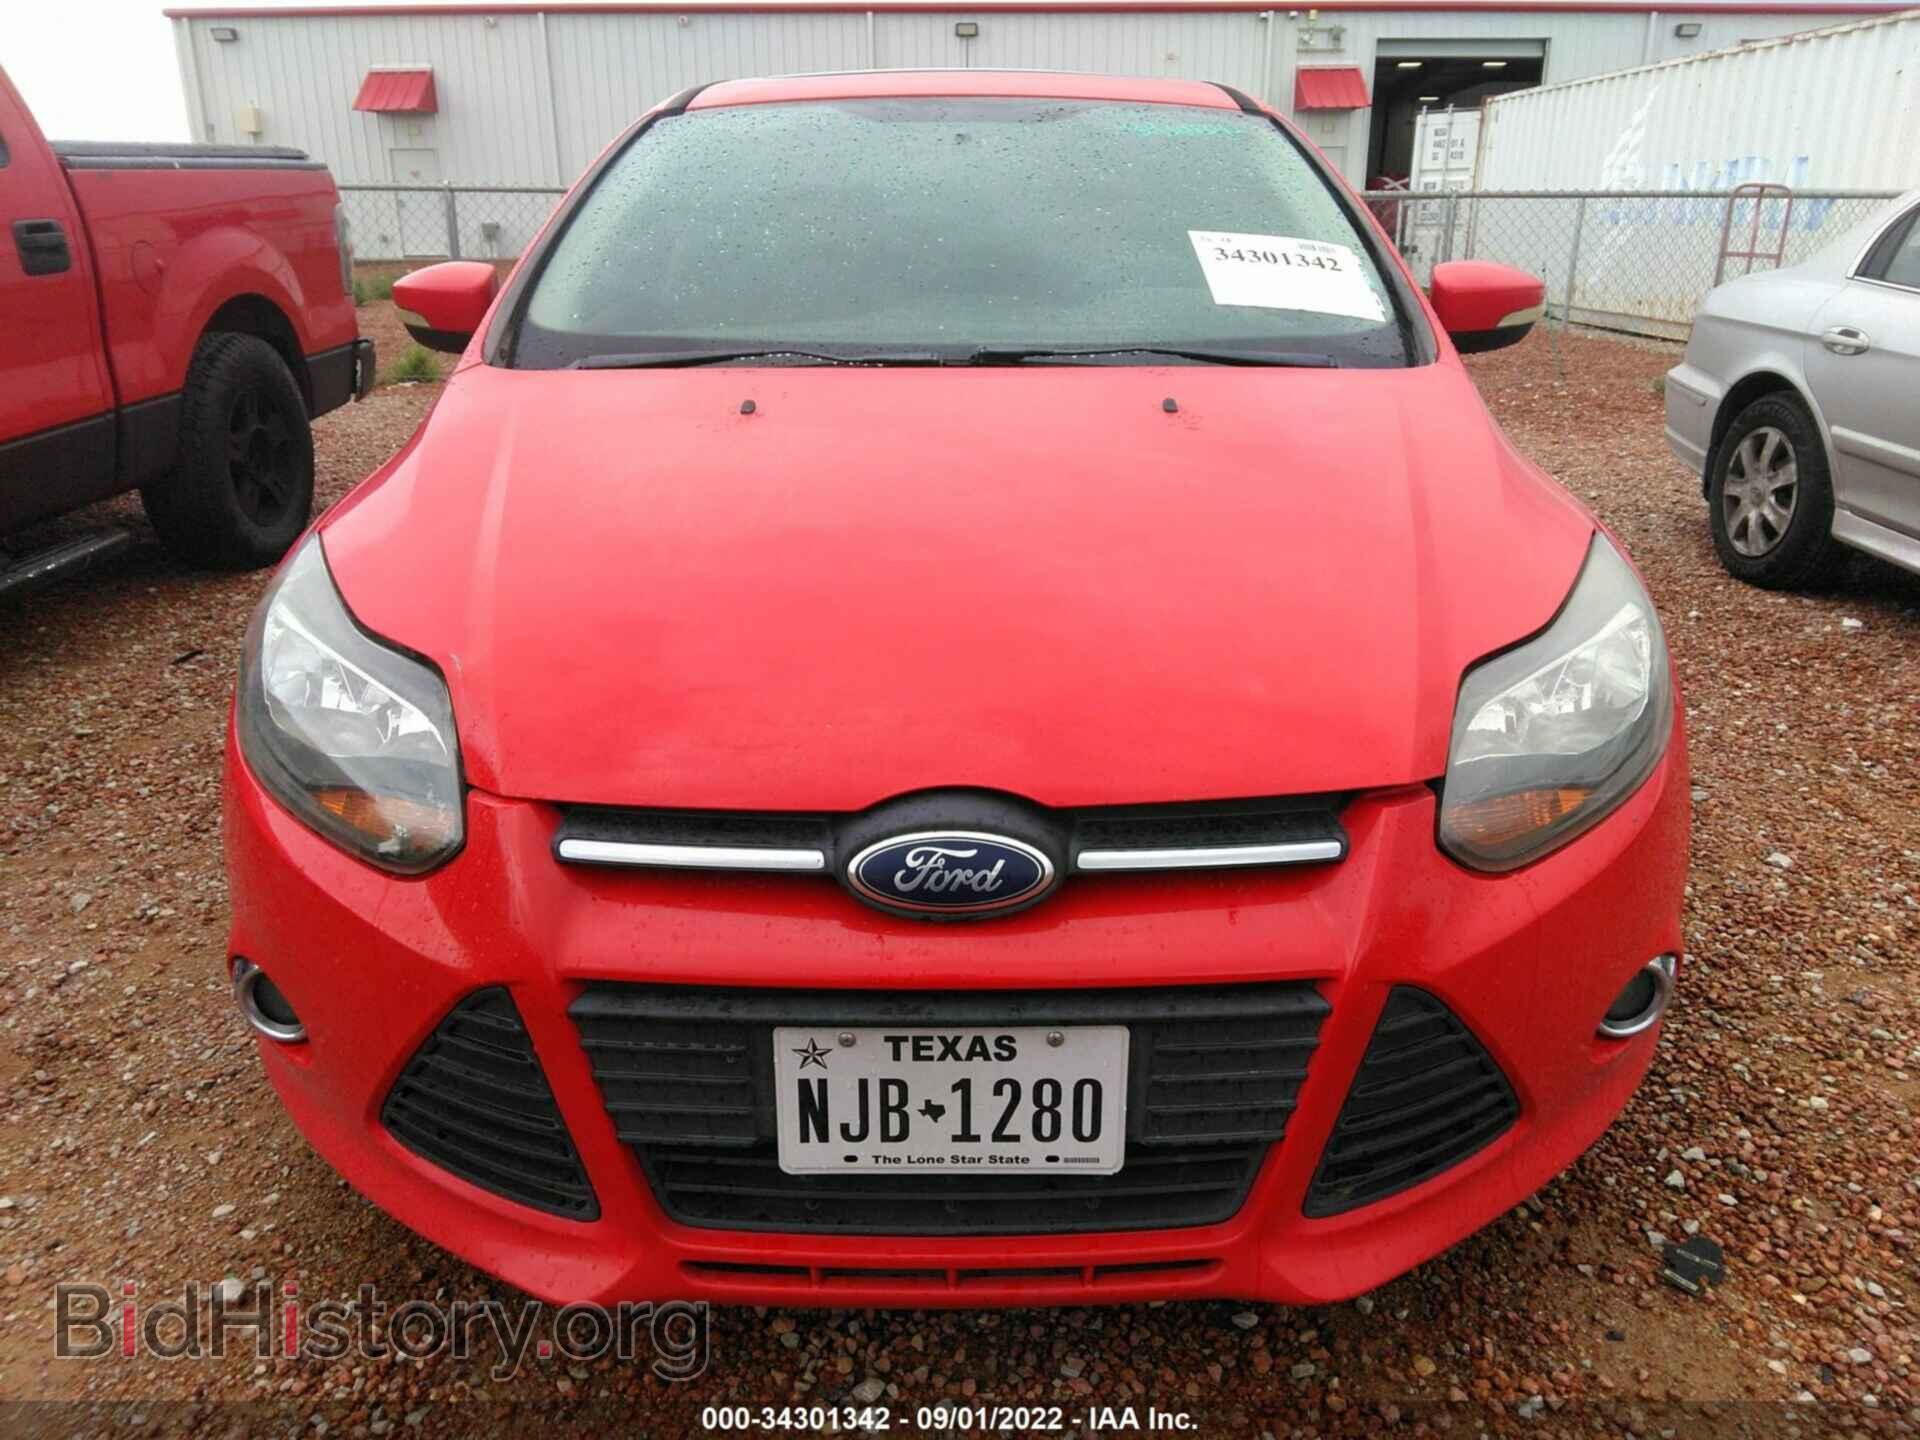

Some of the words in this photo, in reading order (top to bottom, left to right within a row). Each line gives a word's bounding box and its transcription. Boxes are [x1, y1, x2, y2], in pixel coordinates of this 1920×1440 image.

[1214, 247, 1342, 271] 34301342
[894, 846, 1006, 893] Ford
[883, 1034, 1018, 1062] TEXAS
[797, 1078, 910, 1143] NJB
[951, 1078, 1103, 1143] 1280
[872, 1154, 902, 1165] The
[907, 1154, 947, 1165] Lone
[950, 1154, 985, 1165] Star
[988, 1154, 1031, 1165] State
